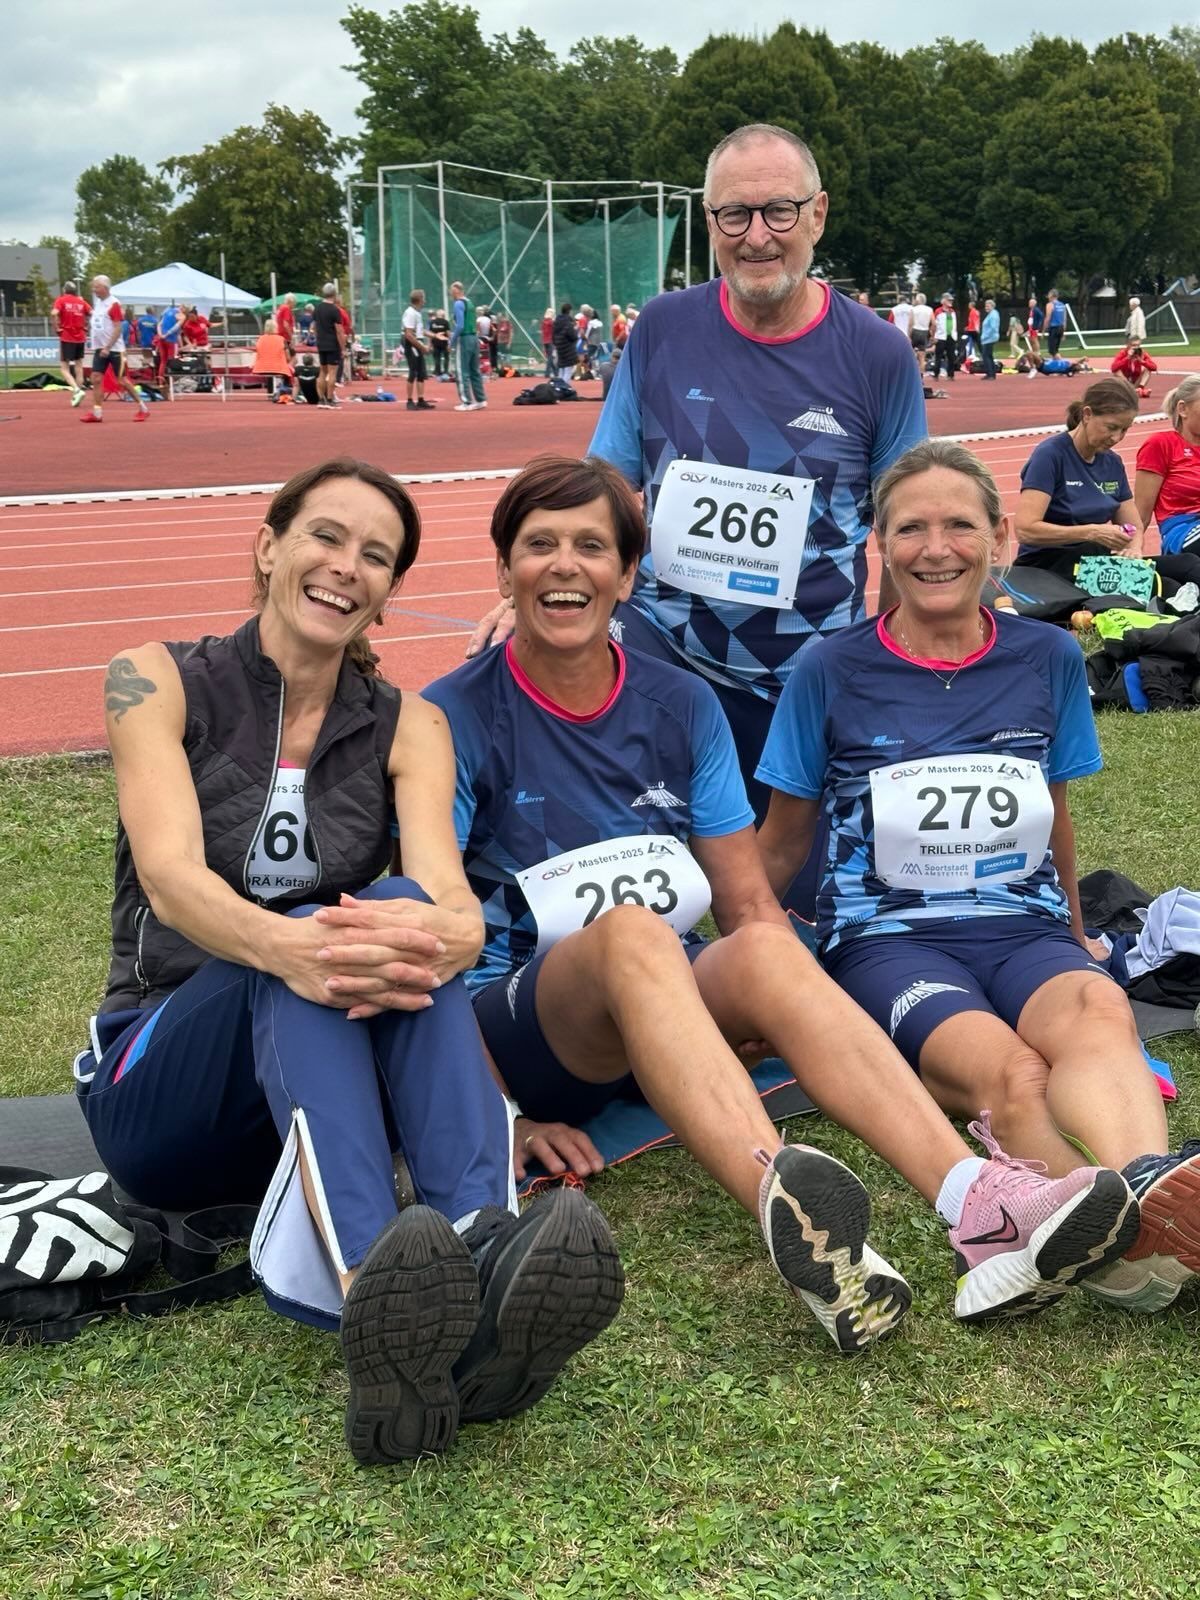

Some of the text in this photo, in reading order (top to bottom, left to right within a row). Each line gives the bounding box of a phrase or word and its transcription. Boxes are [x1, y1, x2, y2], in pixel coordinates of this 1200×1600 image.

[710, 476, 767, 493] Masters 2025
[687, 496, 779, 548] 266
[677, 547, 779, 572] HEIDINGER Wolfram
[928, 765, 994, 774] Masters 2025
[917, 785, 1019, 831] 279
[920, 841, 1017, 855] TRILLER Dagmar
[578, 847, 644, 869] Masters 2025
[925, 863, 969, 873] Sportstadt
[248, 875, 271, 887] RÄ
[575, 869, 678, 928] 263
